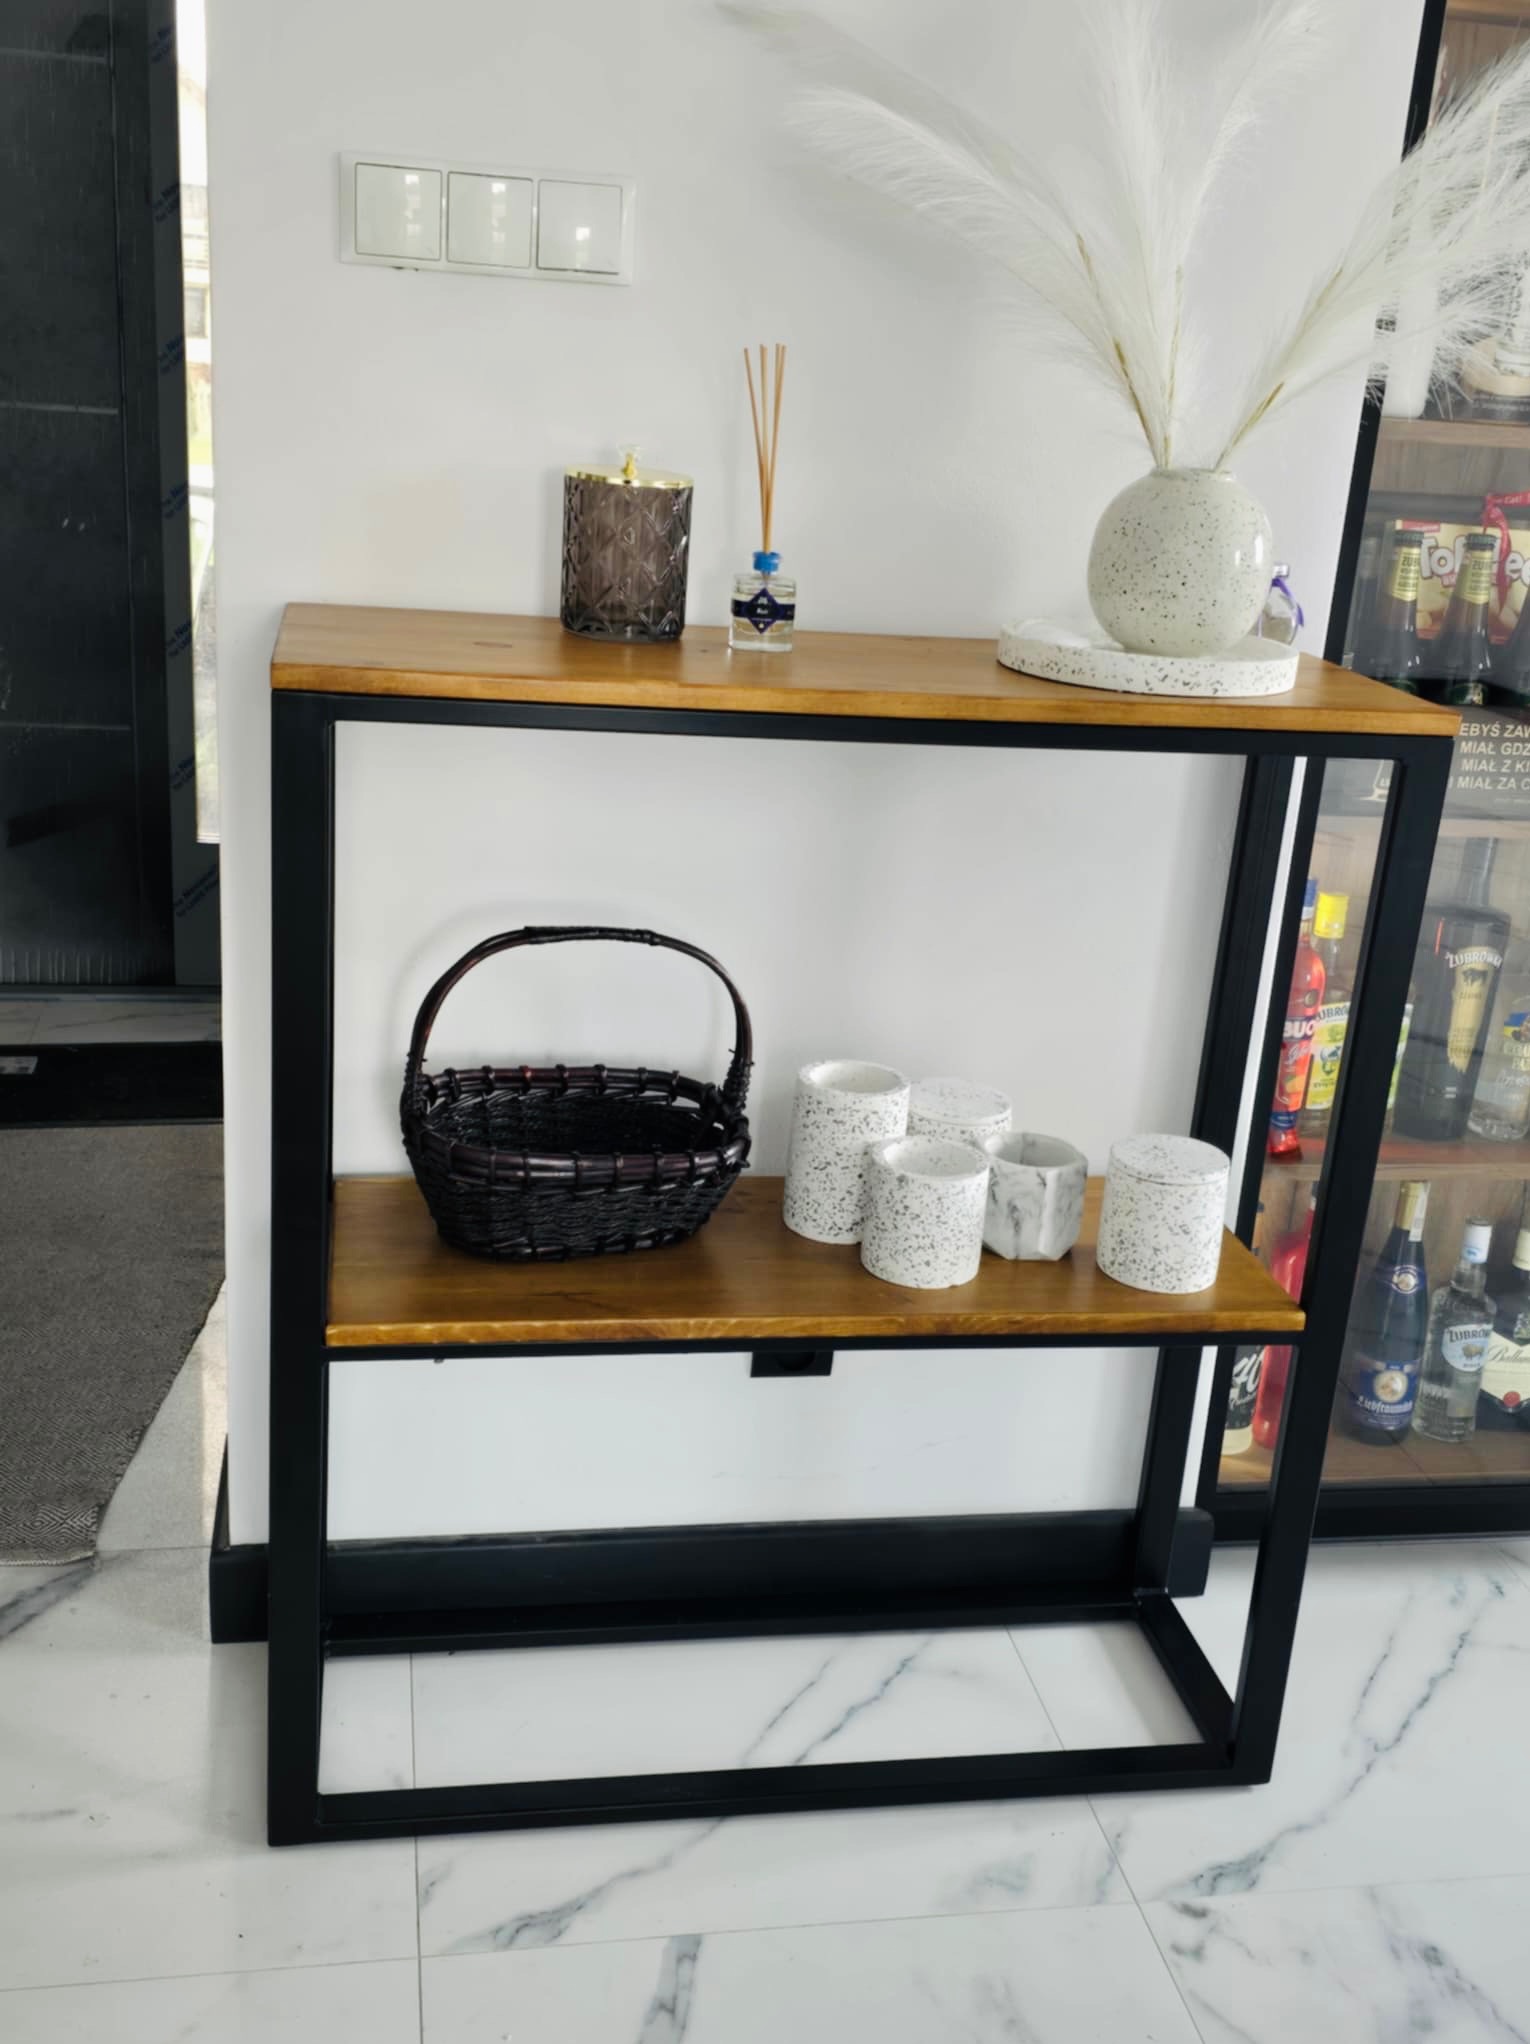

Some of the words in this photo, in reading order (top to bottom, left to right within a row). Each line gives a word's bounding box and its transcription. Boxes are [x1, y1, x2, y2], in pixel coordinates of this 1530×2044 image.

[1460, 741, 1496, 755] MIAŁ
[1461, 759, 1497, 772] MIAŁ
[1501, 760, 1512, 773] Z
[1457, 776, 1493, 790] MIAŁ
[1497, 777, 1516, 790] ZA
